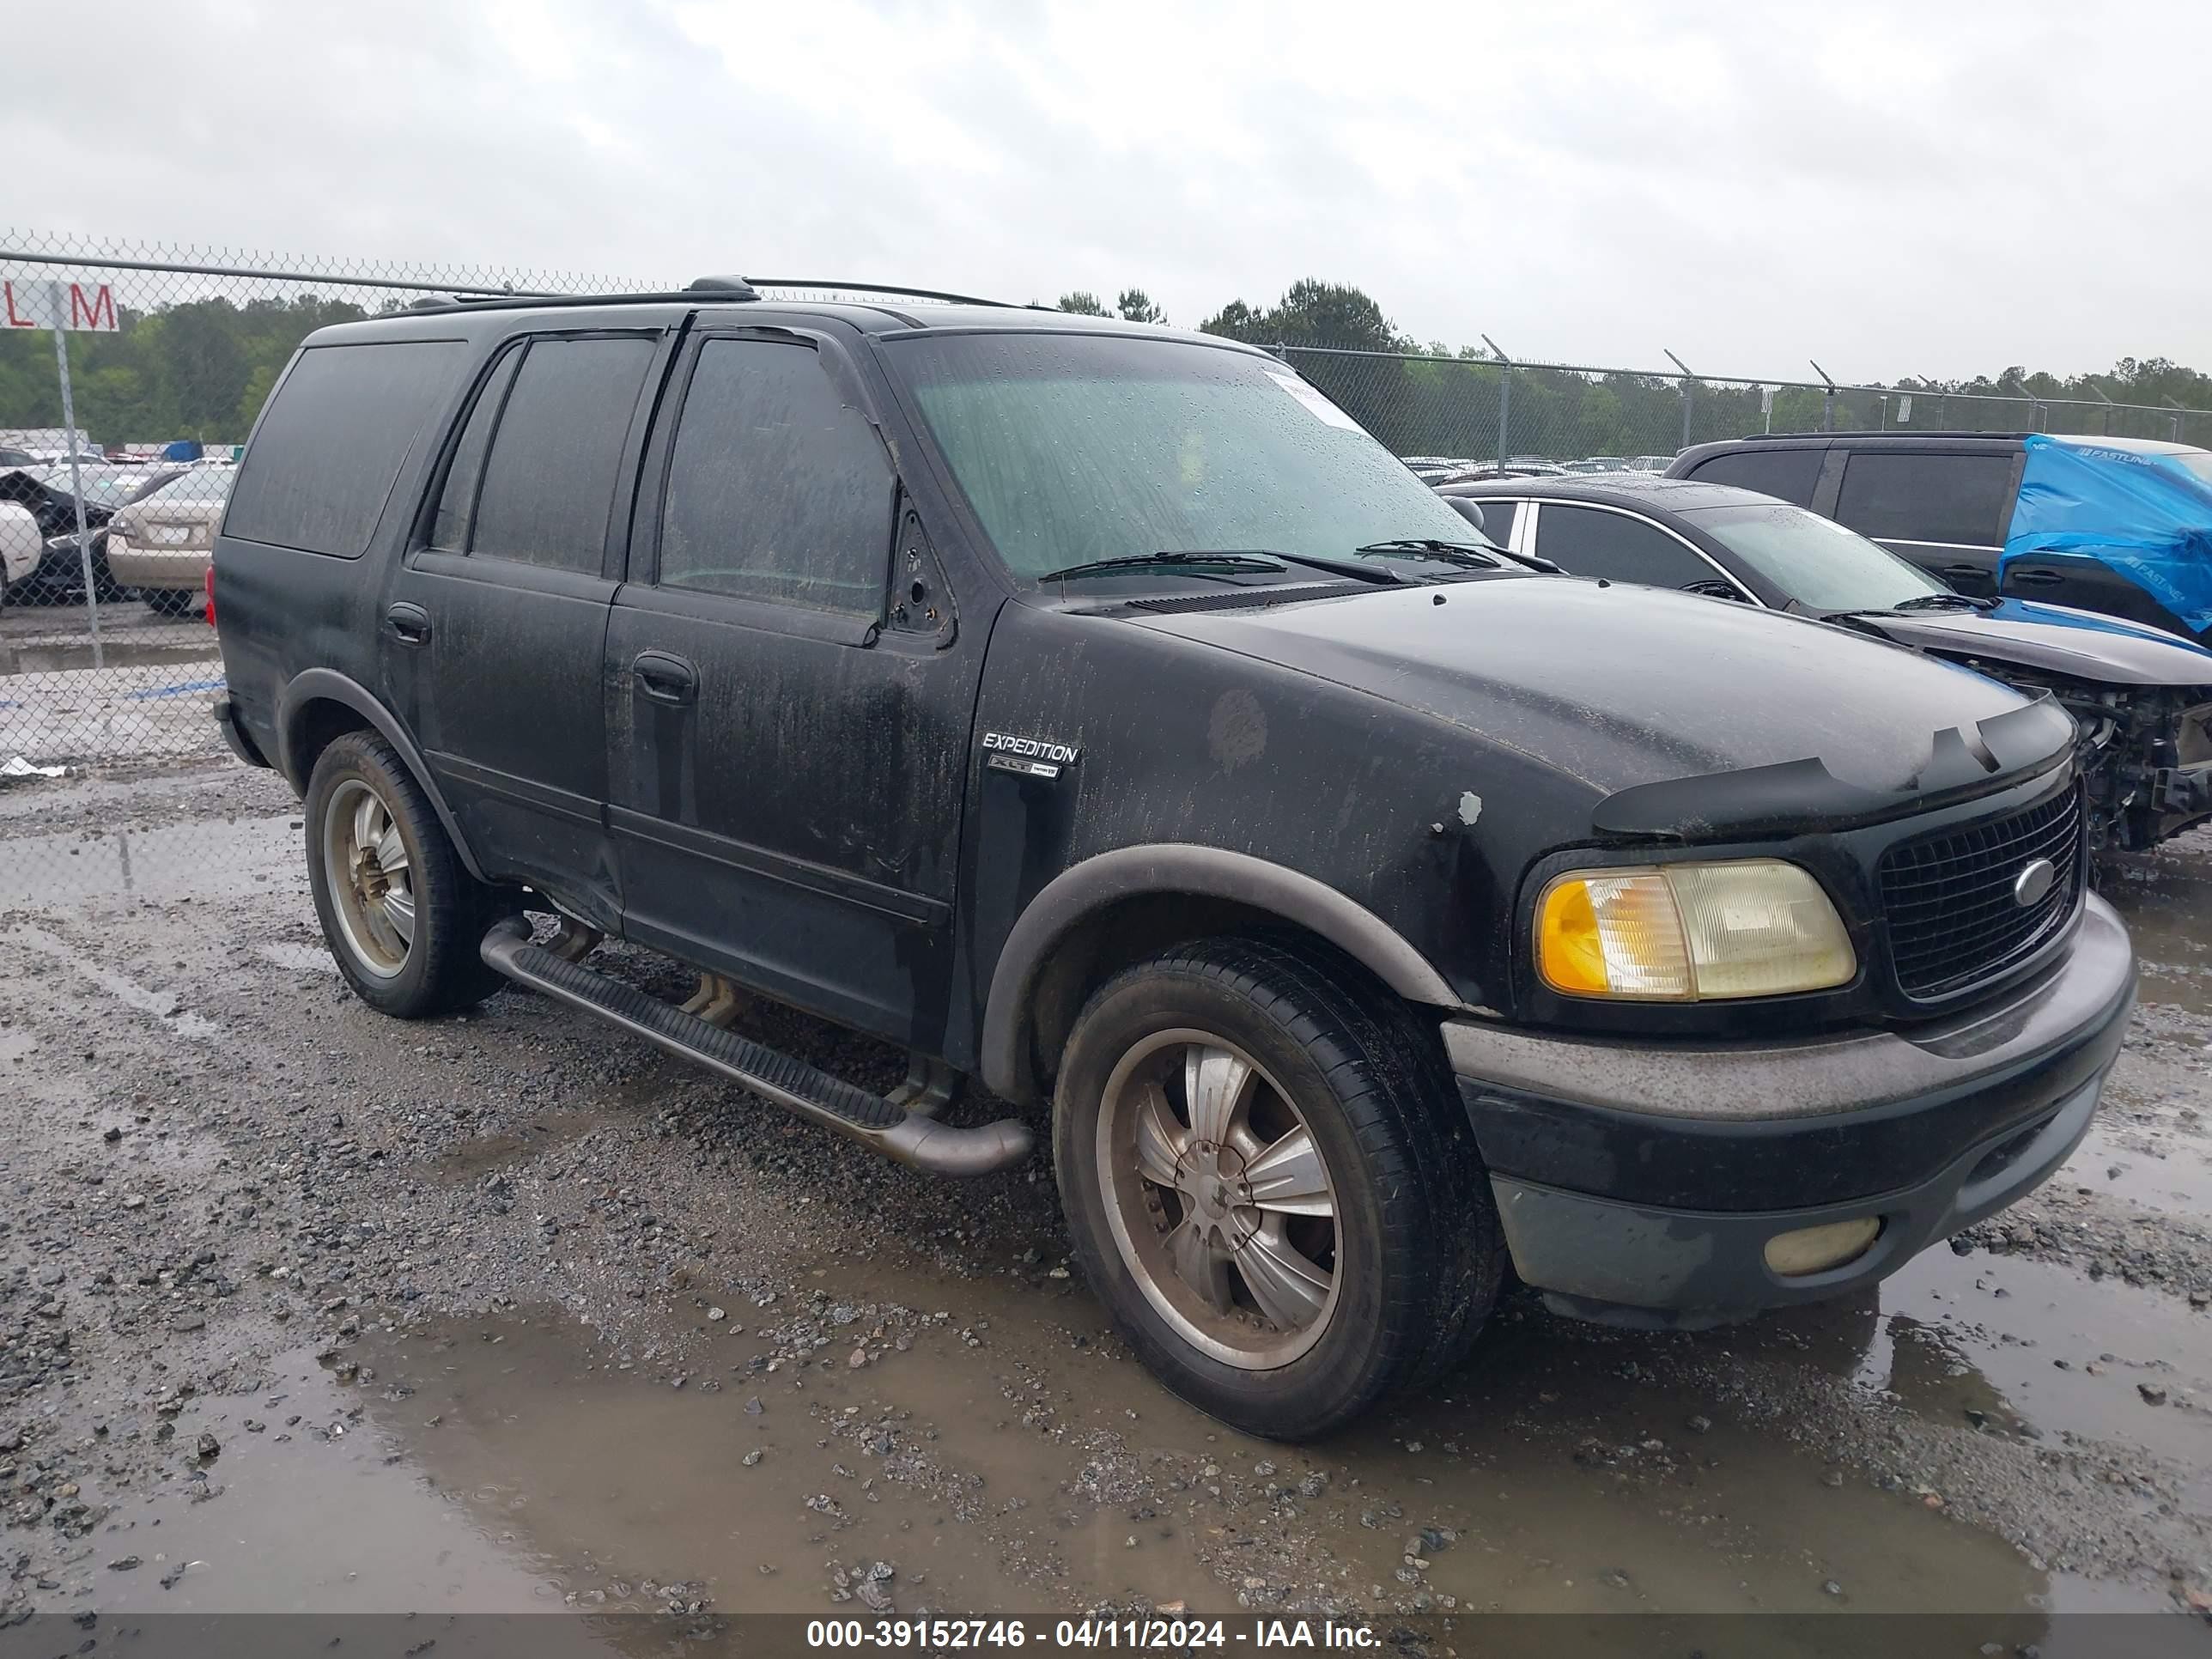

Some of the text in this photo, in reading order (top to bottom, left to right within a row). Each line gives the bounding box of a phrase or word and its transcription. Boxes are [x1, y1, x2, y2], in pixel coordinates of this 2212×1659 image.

[3, 281, 115, 330] L M
[982, 732, 1079, 763] EXPEDITION
[993, 757, 1030, 771] XLT
